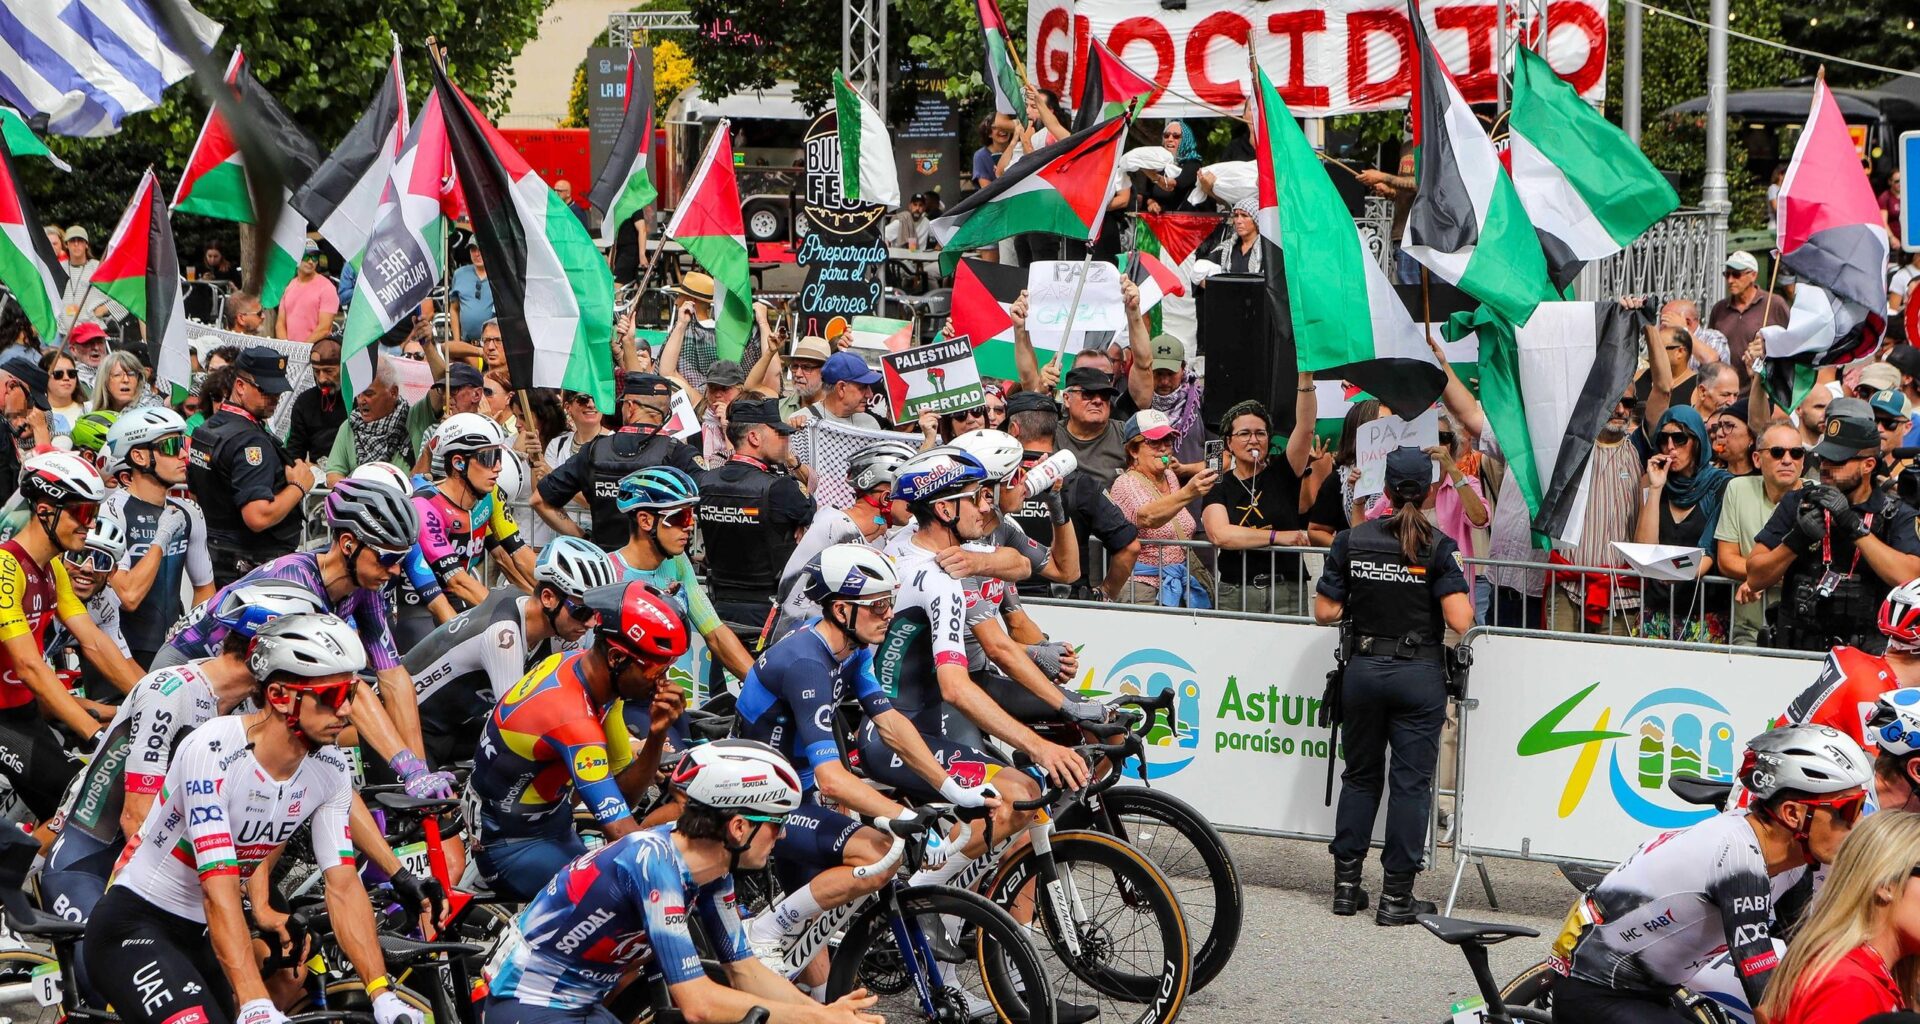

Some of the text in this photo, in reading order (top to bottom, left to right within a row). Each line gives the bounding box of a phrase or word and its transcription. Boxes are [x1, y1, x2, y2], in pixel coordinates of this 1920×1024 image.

[600, 83, 614, 97] LA
[818, 262, 863, 286] para el
[1053, 263, 1107, 283] PAZ
[895, 340, 970, 370] PALESTINA
[907, 389, 981, 417] LIBERTAD
[124, 428, 150, 437] SCOTT
[44, 459, 71, 476] Cofidis
[914, 464, 966, 500] SPECIALIZED
[700, 505, 746, 516] POLICIA
[1022, 501, 1049, 510] ICIA
[359, 510, 388, 536] GIANT
[700, 513, 760, 524] NACIONAL
[549, 567, 572, 588] SCOTT
[1350, 560, 1410, 573] POLICIA
[1350, 570, 1427, 584] NACIONAL
[635, 596, 675, 632] TREK
[948, 591, 964, 644] BOSS
[258, 636, 281, 649] MET
[316, 629, 346, 657] MET
[1216, 674, 1323, 728] Astur
[143, 708, 173, 763] BOSS
[1215, 728, 1295, 755] paraíso
[314, 750, 346, 773] Analog
[1757, 753, 1785, 767] MET
[1823, 744, 1855, 772] MET
[741, 780, 769, 789] SOUDAL
[1752, 769, 1777, 788] G42
[710, 787, 788, 805] SPECIALIZED
[153, 831, 168, 848] IHC
[237, 819, 297, 844] UAE
[195, 835, 231, 851] Emirates
[52, 893, 89, 924] BO
[555, 907, 617, 956] SOUDAL
[1618, 927, 1643, 943] IHC
[44, 977, 52, 1001] 6
[132, 959, 175, 1017] UAE
